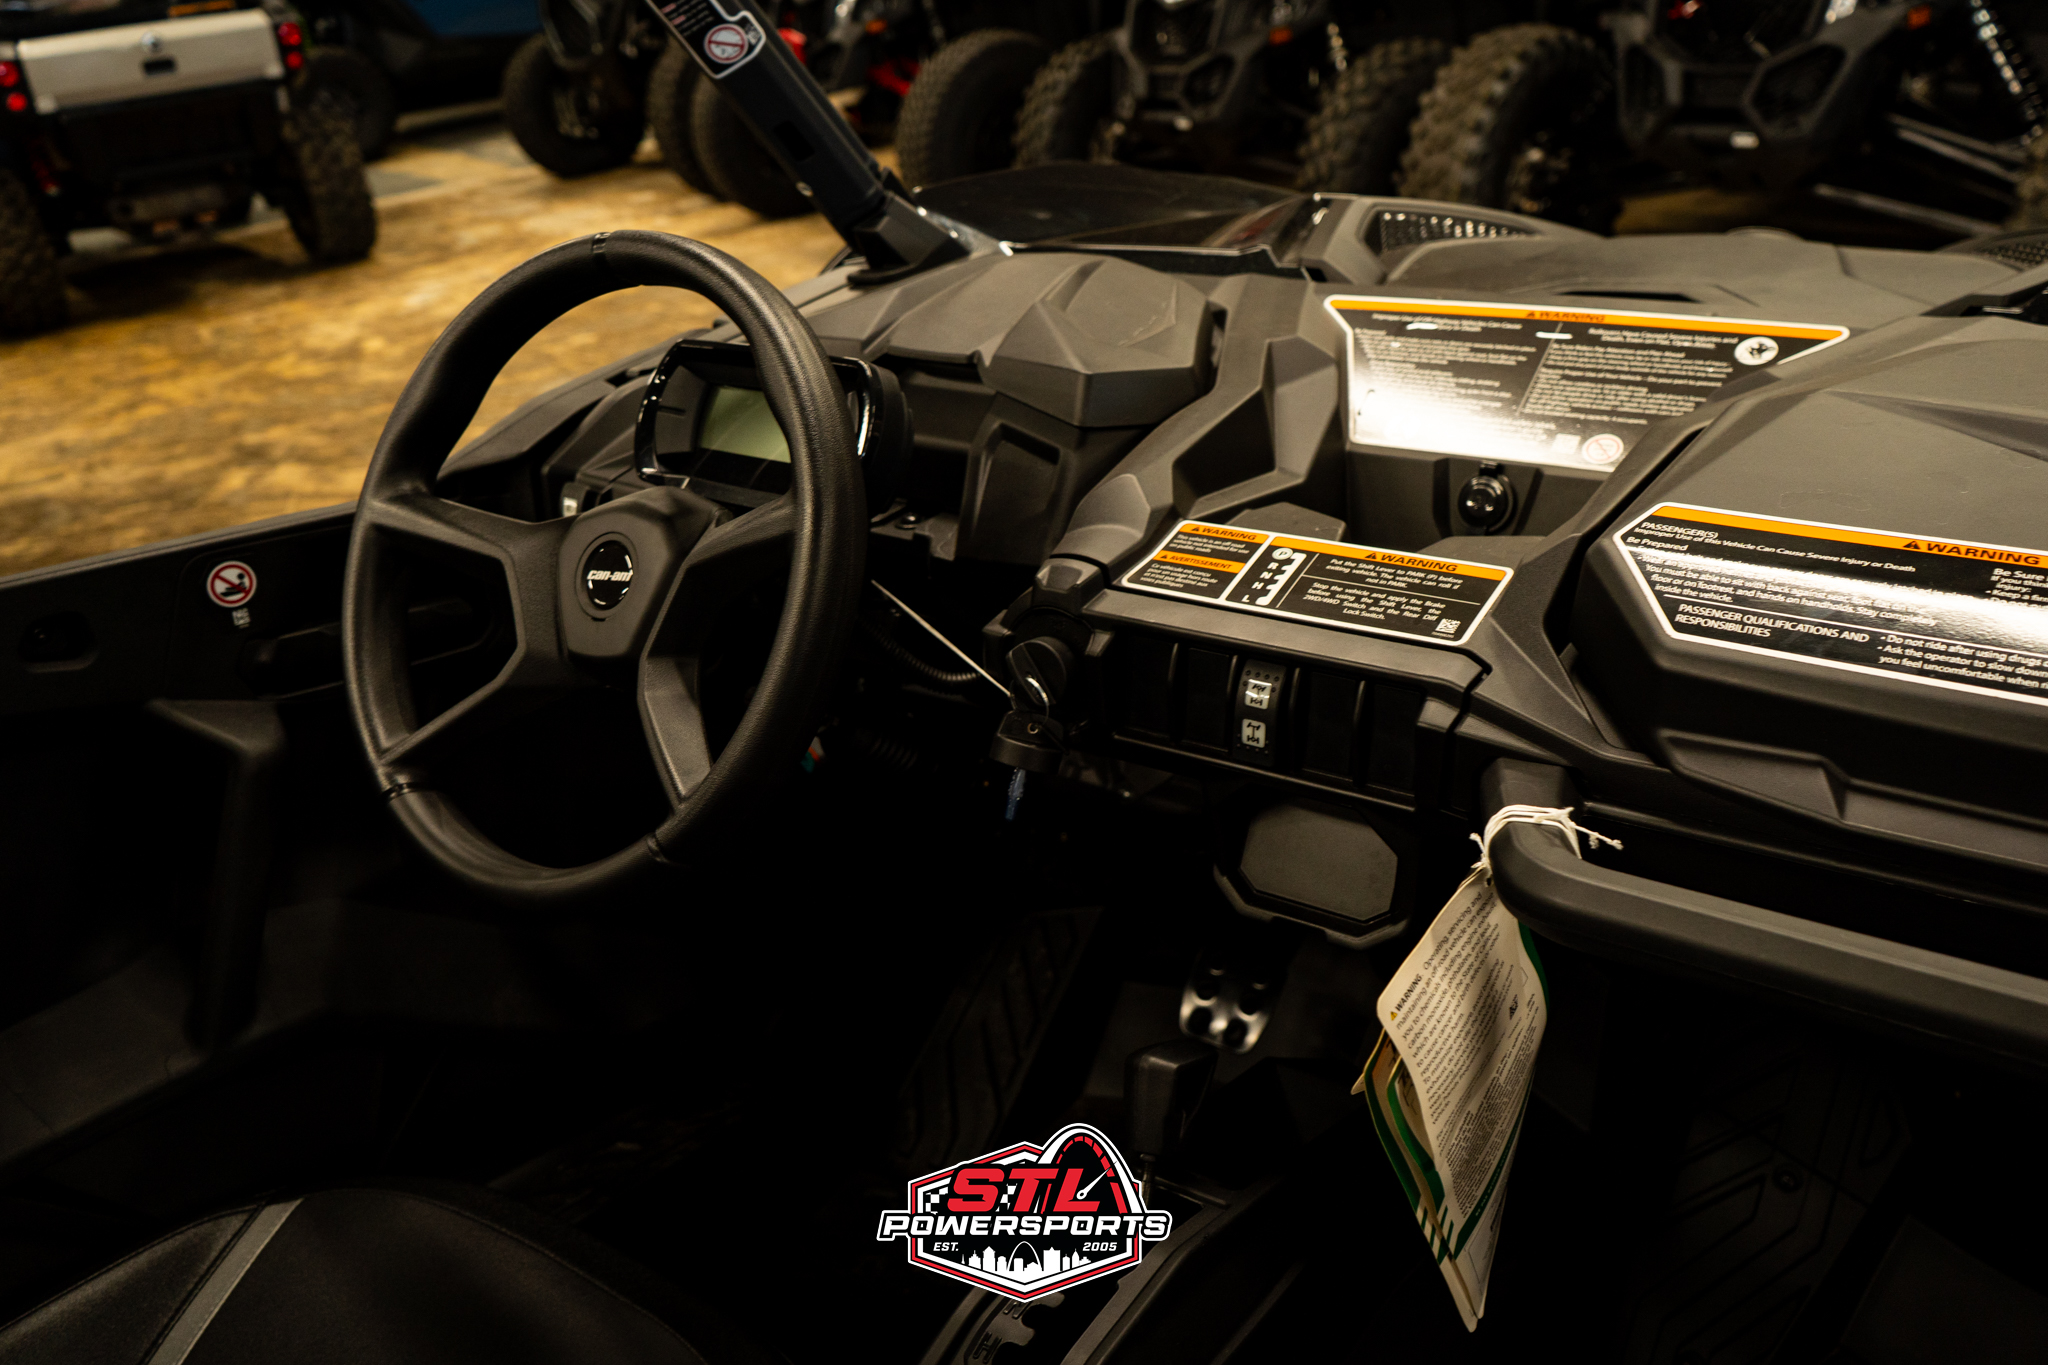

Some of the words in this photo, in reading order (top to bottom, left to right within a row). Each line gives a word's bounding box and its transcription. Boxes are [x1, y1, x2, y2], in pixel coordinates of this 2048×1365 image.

[1539, 312, 1605, 322] WARNING
[1202, 527, 1257, 541] WARNING
[1641, 521, 1718, 539] PASSENGER(S)
[1634, 527, 1667, 538] Improper
[1669, 532, 1686, 540] Use
[1699, 536, 1721, 545] this
[1722, 539, 1755, 549] Vehicle
[1757, 544, 1775, 552] Can
[1776, 546, 1805, 556] Cause
[1807, 551, 1839, 561] Severe
[1840, 555, 1870, 567] Injury
[1884, 561, 1915, 571] Death
[1641, 538, 1688, 551] Prepared
[1927, 543, 2040, 565] WARNING
[1170, 555, 1232, 570] AVERTISSEMENT
[1357, 562, 1375, 571] Shift
[1375, 565, 1396, 574] Lever
[1406, 570, 1425, 578] PARK
[1426, 573, 1438, 581] (P)
[1438, 575, 1463, 584] before
[1381, 554, 1458, 572] WARNING
[587, 570, 631, 582] can-am
[1326, 566, 1350, 575] exiting
[1352, 569, 1378, 578] vehicle.
[1395, 576, 1421, 584] vehicle
[1387, 580, 1408, 588] PARK.
[1993, 568, 2012, 577] Be
[2013, 570, 2044, 581] Sure
[1307, 588, 1331, 597] before
[1335, 594, 1356, 603] using
[1378, 599, 1397, 608] Shift
[1400, 603, 1422, 614] Lever,
[1312, 582, 1329, 592] Stop
[1344, 588, 1370, 597] vehicle
[1387, 595, 1408, 604] apply
[1424, 600, 1446, 609] Brake
[1651, 574, 1671, 584] floor
[1736, 589, 1754, 597] and
[1756, 590, 1784, 602] hands
[1857, 606, 1880, 618] Stay
[1655, 584, 1681, 594] inside
[1682, 588, 1698, 597] the
[1699, 592, 1733, 603] vehicle.
[1992, 589, 2021, 600] Keep
[1302, 594, 1340, 606] 2WD/4WD
[1342, 600, 1366, 610] Switch
[1402, 610, 1421, 619] Rear
[1422, 613, 1439, 622] Diff
[1342, 608, 1360, 616] Lock
[1360, 610, 1386, 620] Switch.
[1675, 614, 1771, 637] RESPONSIBILITIES
[1678, 604, 1742, 622] PASSENGER
[1743, 614, 1839, 637] QUALIFICATIONS
[1840, 629, 1869, 642] AND
[1883, 644, 1903, 655] Ask
[1905, 648, 1923, 658] the
[1924, 653, 1972, 666] operator
[1973, 659, 1986, 668] to
[1987, 662, 2014, 673] slow
[1887, 634, 1902, 644] Do
[1905, 639, 1923, 647] not
[1925, 641, 1947, 651] ride
[1948, 645, 1974, 656] after
[1976, 650, 2007, 663] using
[2008, 654, 2041, 667] drugs
[1878, 657, 1900, 666] you
[1902, 658, 1922, 670] feel
[1923, 664, 2005, 683] uncomfortable
[2007, 677, 2039, 688] when
[1448, 907, 1473, 936] servicing
[1471, 892, 1483, 908] and
[1396, 987, 1429, 1030] maintaining
[1424, 977, 1433, 988] an
[1430, 949, 1451, 978] off-road
[1449, 927, 1468, 952] vehicle
[1466, 915, 1478, 928] can
[1476, 892, 1495, 916] expose
[1402, 1023, 1415, 1040] you
[1412, 1016, 1420, 1024] to
[1418, 982, 1442, 1016] chemicals
[1438, 951, 1464, 982] including
[1461, 928, 1479, 952] engine
[1407, 1023, 1427, 1050] carbon
[1470, 937, 1482, 953] and
